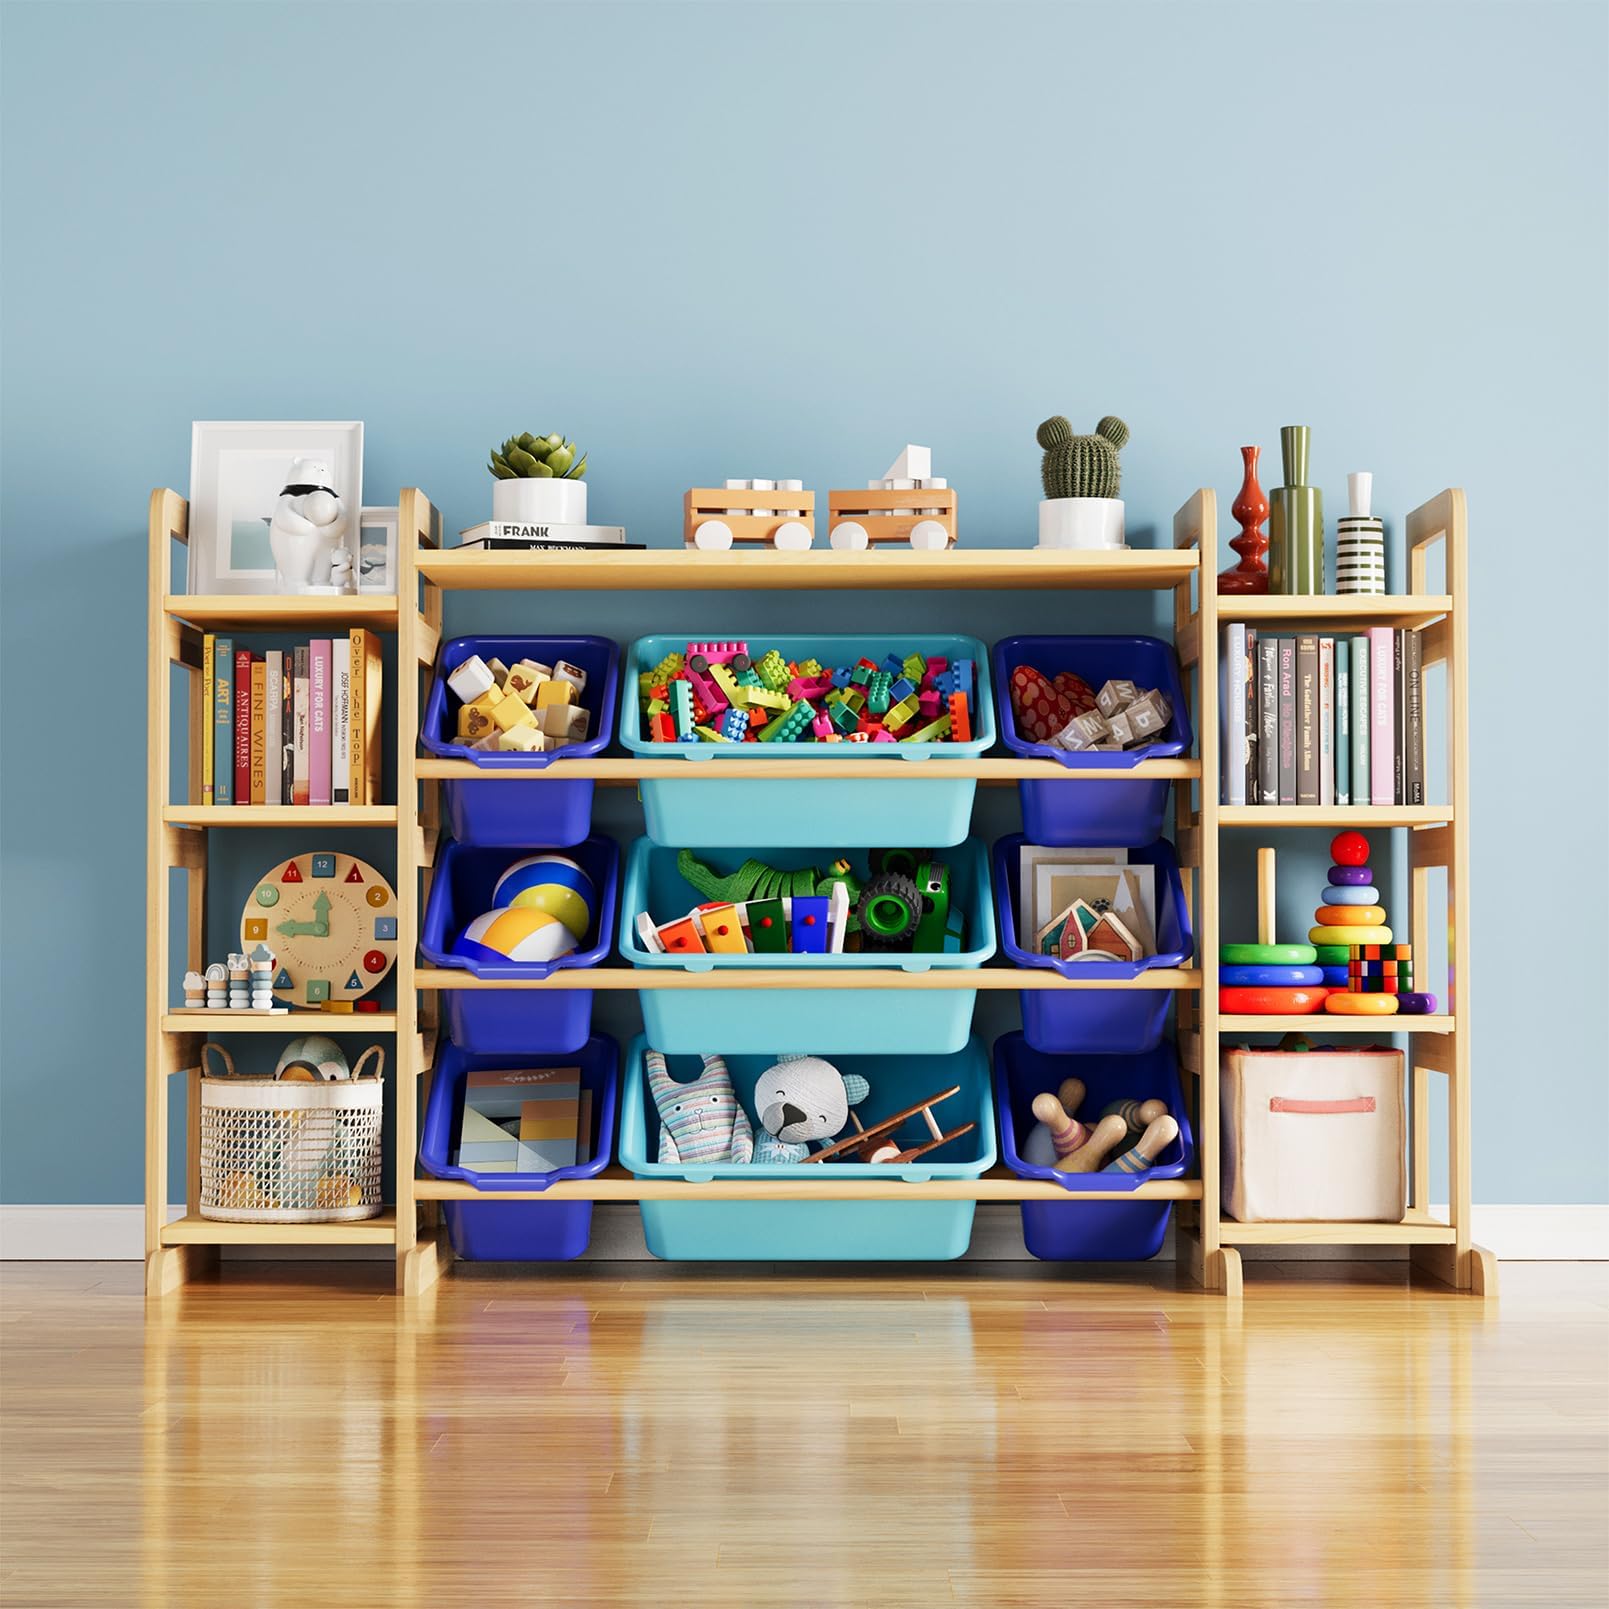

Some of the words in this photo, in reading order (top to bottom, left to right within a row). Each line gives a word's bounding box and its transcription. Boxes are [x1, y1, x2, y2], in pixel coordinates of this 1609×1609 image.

[503, 525, 549, 537] FRANK
[352, 635, 362, 677] Over
[1233, 636, 1242, 676] LUXURY
[1282, 648, 1292, 669] Ron
[1359, 648, 1367, 694] EXECUTIVE
[1376, 646, 1387, 680] LUXURY
[314, 656, 324, 689] LUXURY
[341, 671, 349, 688] JOSEF
[1282, 672, 1292, 696] Arad
[1303, 674, 1312, 686] The
[217, 678, 229, 705] ART
[253, 682, 263, 721] FINE
[269, 670, 278, 711] SCARPA
[314, 691, 324, 708] FOR
[341, 689, 349, 723] HOFFMANN
[353, 689, 361, 719] the
[1376, 682, 1387, 701] FOR
[239, 690, 249, 768] ANTIQUAIRES
[314, 710, 324, 732] CATS
[1359, 696, 1367, 736] ESCAPES
[1376, 703, 1387, 726] CATS
[253, 729, 263, 789] WINES
[352, 728, 361, 764] Top
[253, 926, 259, 934] 9
